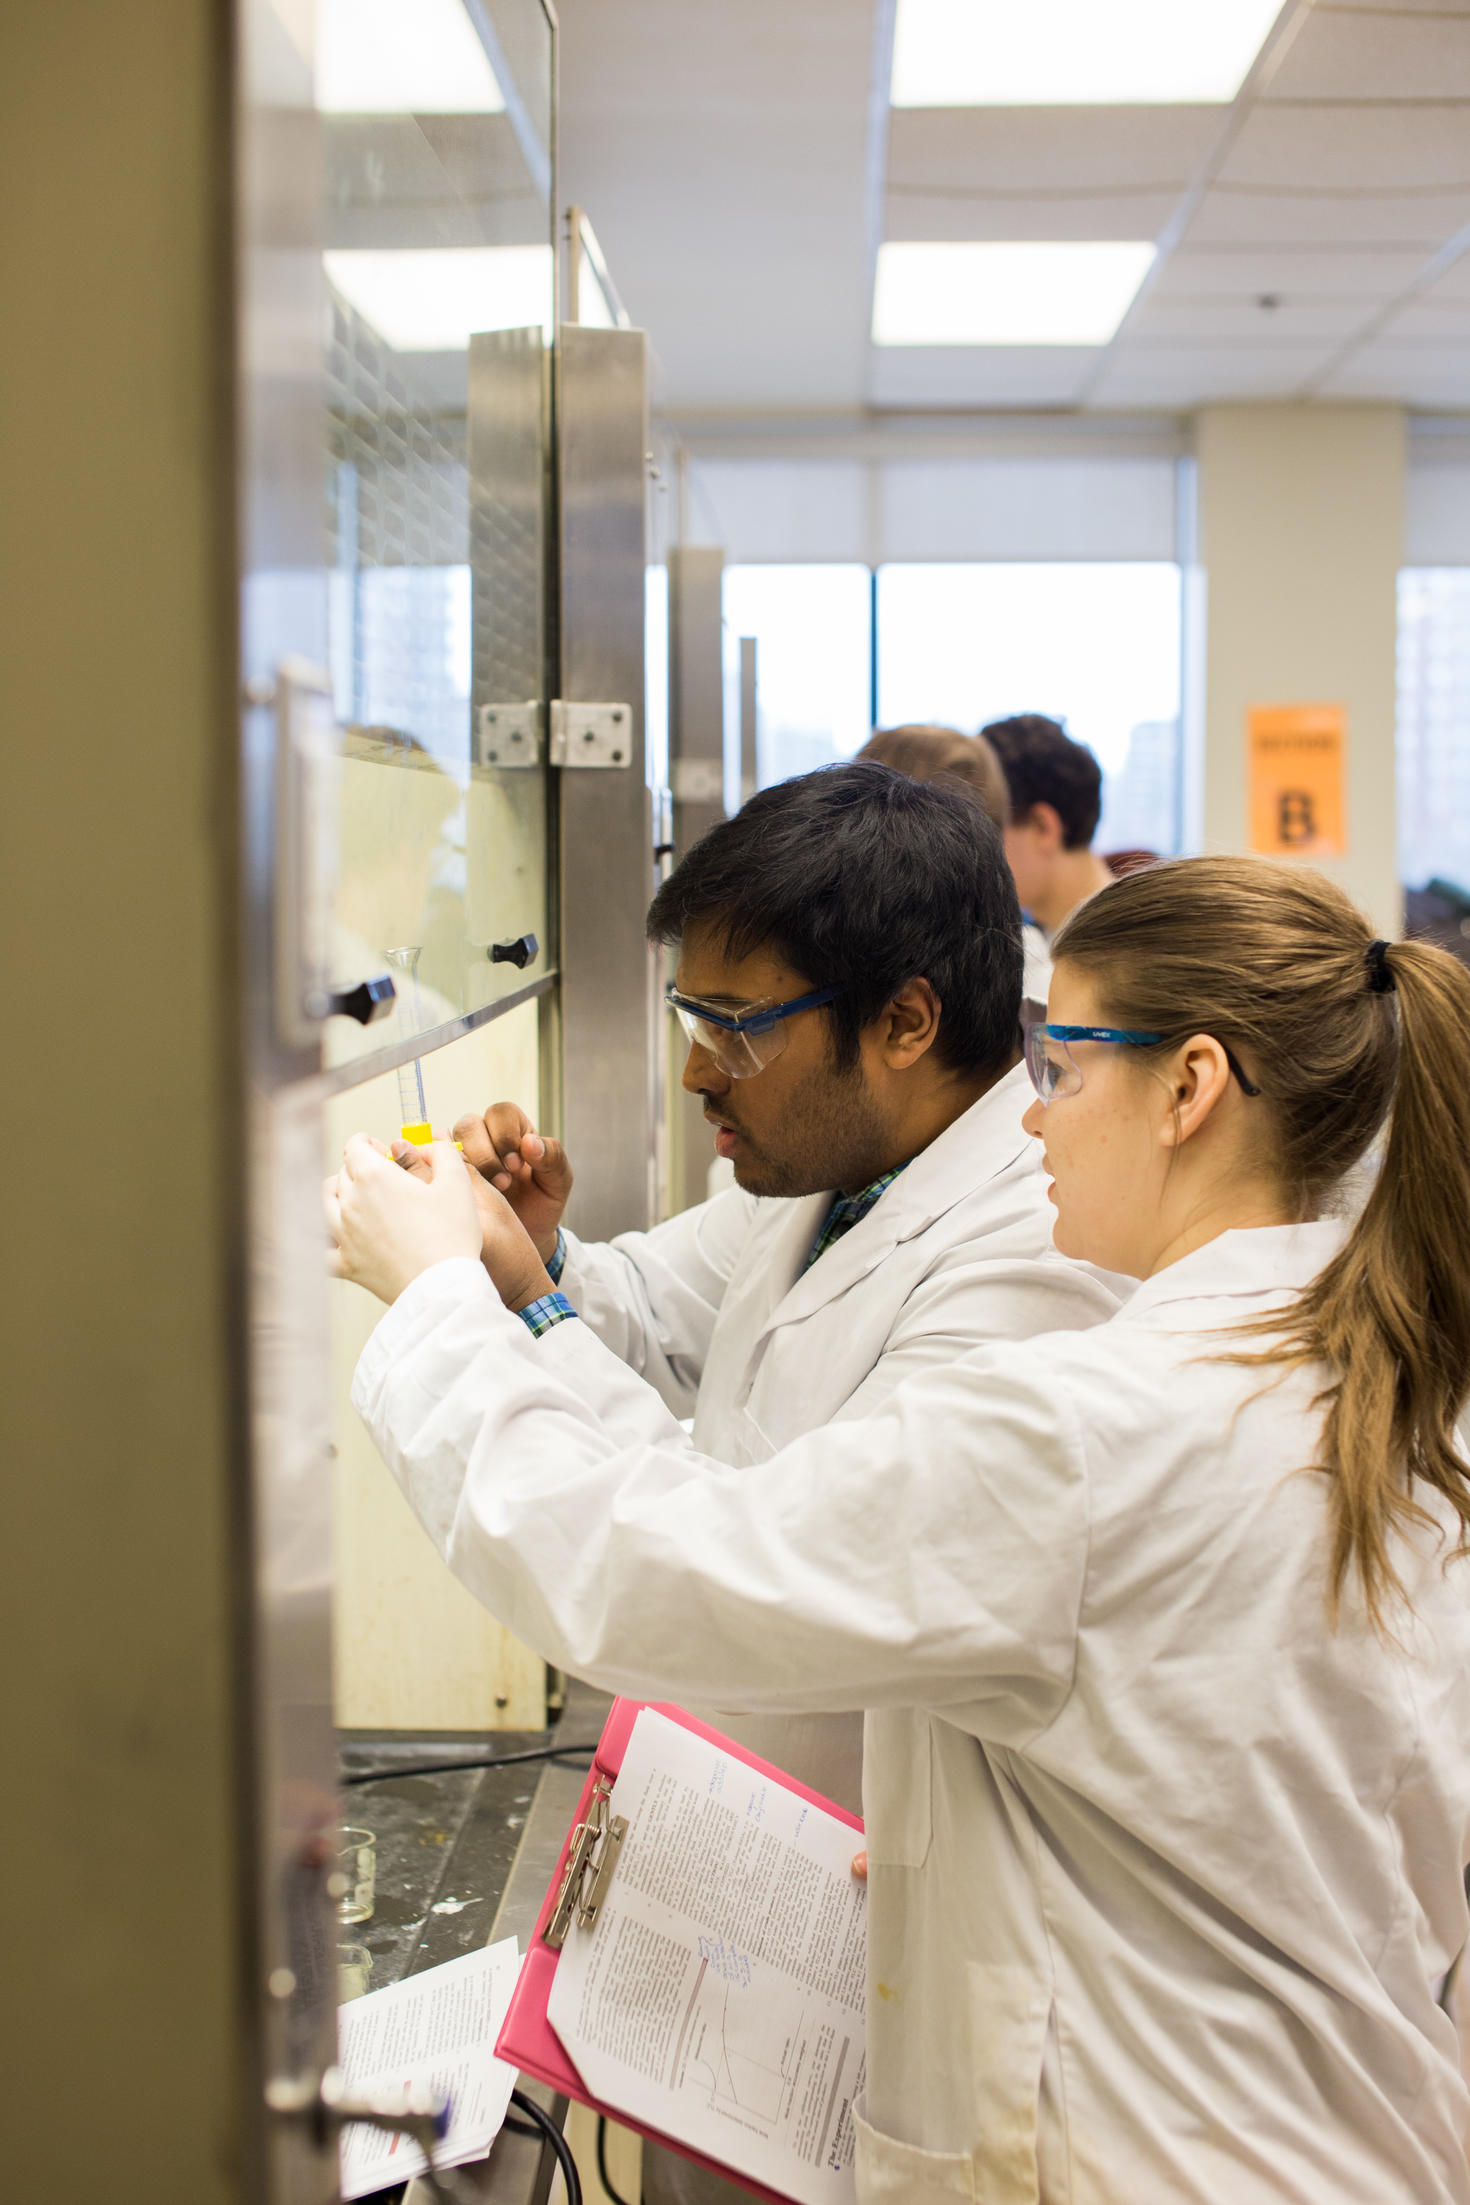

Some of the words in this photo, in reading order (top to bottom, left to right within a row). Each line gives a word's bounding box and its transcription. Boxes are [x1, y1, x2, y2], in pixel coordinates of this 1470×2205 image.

[1278, 789, 1317, 844] B
[828, 2149, 836, 2166] The
[832, 2098, 848, 2148] Experiment
